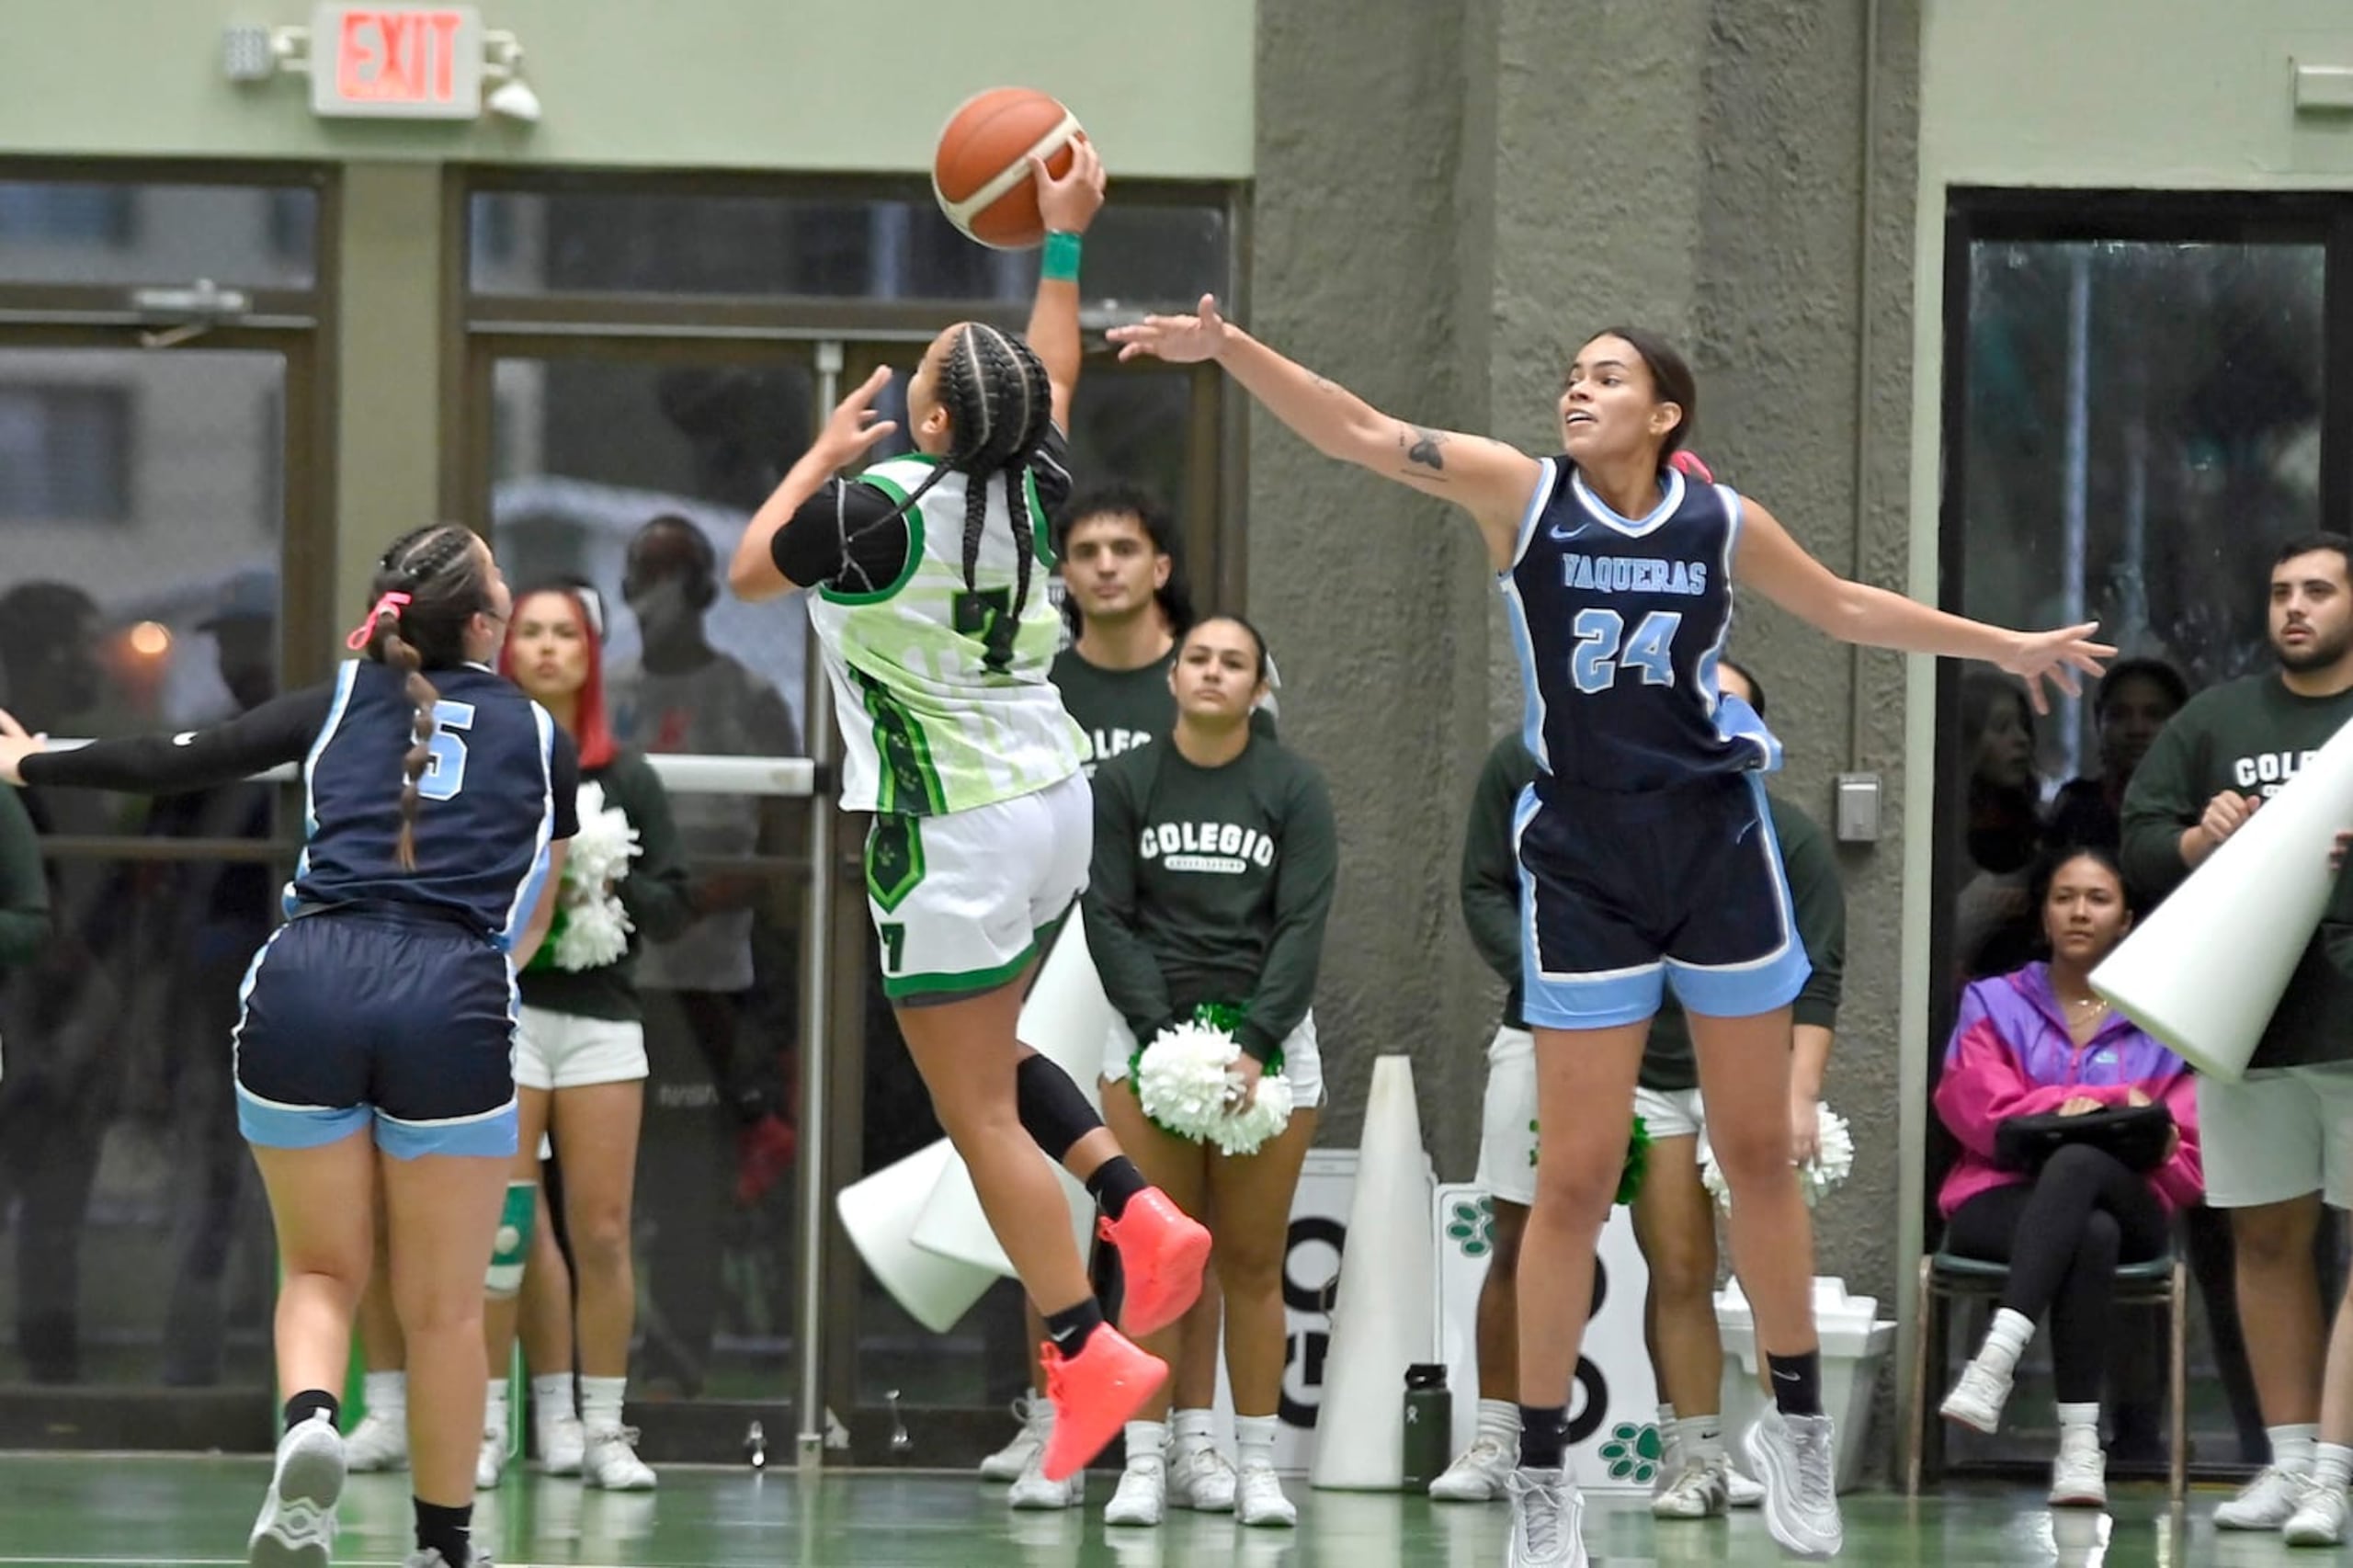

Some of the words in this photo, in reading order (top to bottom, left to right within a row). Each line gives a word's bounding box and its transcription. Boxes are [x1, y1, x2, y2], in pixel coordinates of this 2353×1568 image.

[336, 12, 462, 102] EXIT
[1563, 552, 1707, 595] VAQUERAS
[1573, 608, 1682, 694] 24
[403, 699, 475, 801] 5
[1140, 821, 1275, 868] COLEGIO
[880, 923, 905, 972] 7
